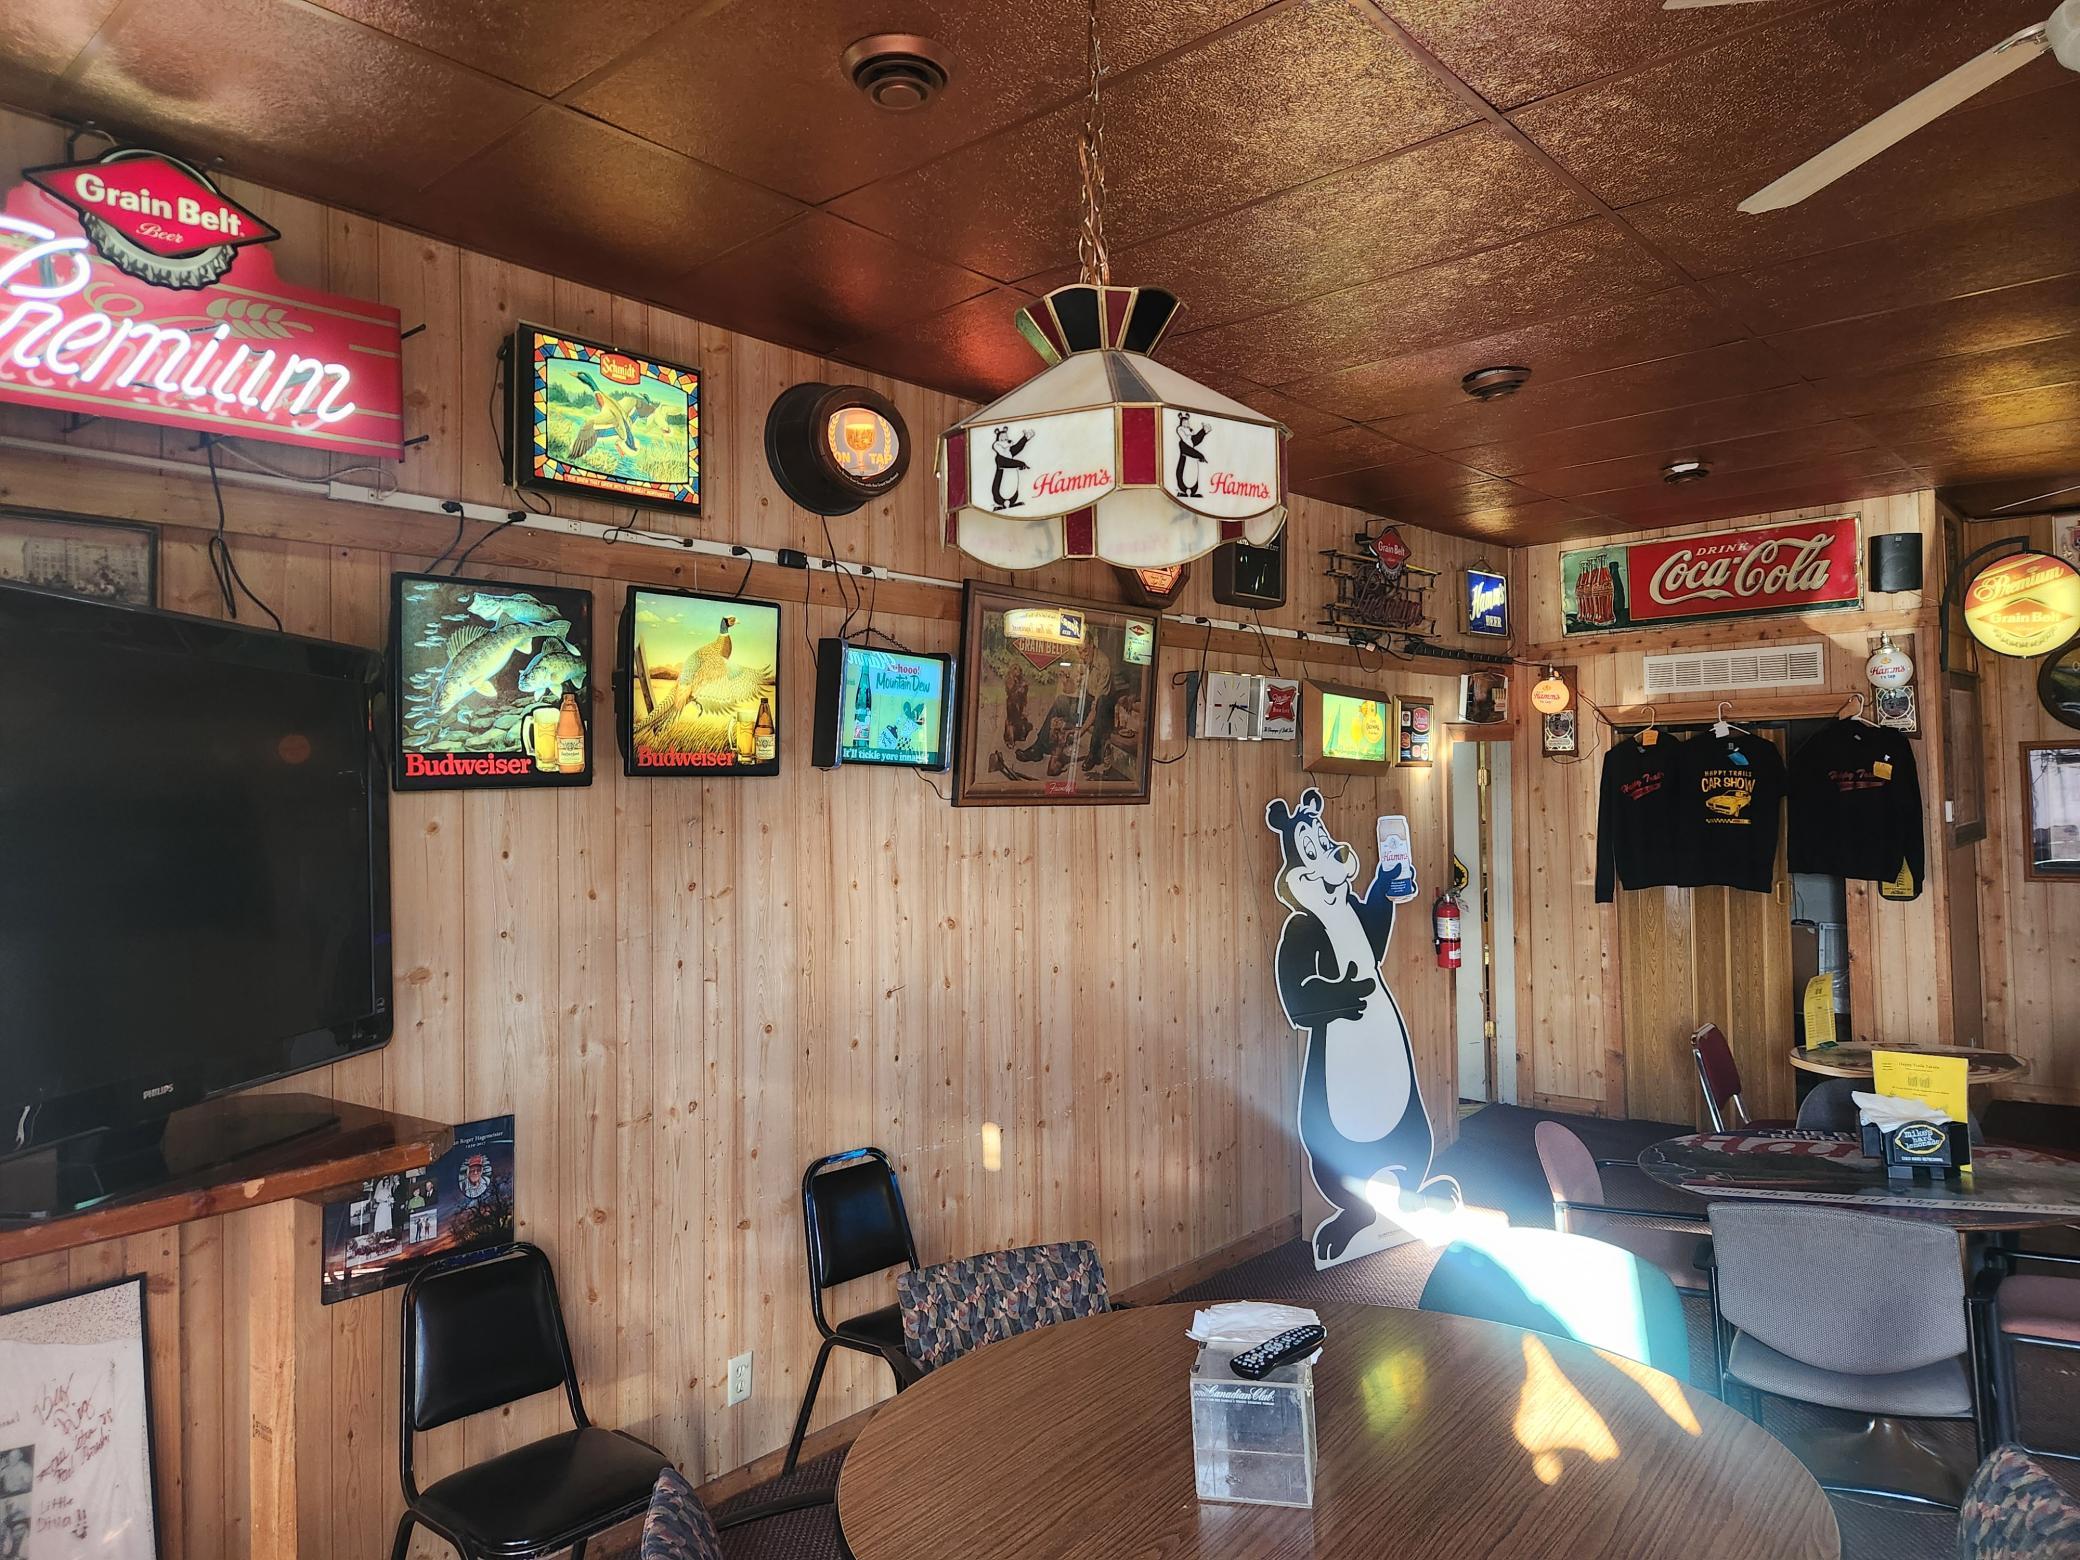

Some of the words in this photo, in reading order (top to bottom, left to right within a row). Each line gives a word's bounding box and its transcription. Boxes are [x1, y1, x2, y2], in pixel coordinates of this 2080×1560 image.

[75, 172, 173, 220] Grain
[177, 197, 243, 237] Belt
[135, 222, 184, 244] Beer
[602, 356, 636, 379] Schmidt
[869, 452, 893, 465] TAP
[1032, 470, 1113, 499] Hamm's
[1209, 472, 1271, 500] Hamm's
[1378, 541, 1394, 554] Grain
[1394, 545, 1405, 556] Belt
[1696, 543, 1749, 557] DRINK
[1650, 533, 1836, 605] Coca-Cola
[1973, 566, 2064, 602] Premium
[1470, 581, 1504, 620] Hamm's
[1990, 611, 2030, 623] Grain
[2032, 611, 2060, 623] Belt
[1020, 638, 1043, 652] GRAIN
[875, 672, 912, 690] Mountain
[910, 675, 931, 693] Dew
[637, 746, 736, 767] Budweiser
[858, 750, 881, 760] tickle
[881, 753, 898, 762] yore
[405, 753, 531, 777] Budweiser
[1701, 777, 1722, 792] CAR
[1723, 777, 1756, 793] SHOW
[143, 1083, 174, 1100] PHILIPS
[1903, 1129, 1934, 1138] mike's
[1912, 1135, 1932, 1144] hard
[1904, 1139, 1941, 1149] lemonade
[1206, 1384, 1251, 1400] Canadian
[1250, 1387, 1275, 1401] Club
